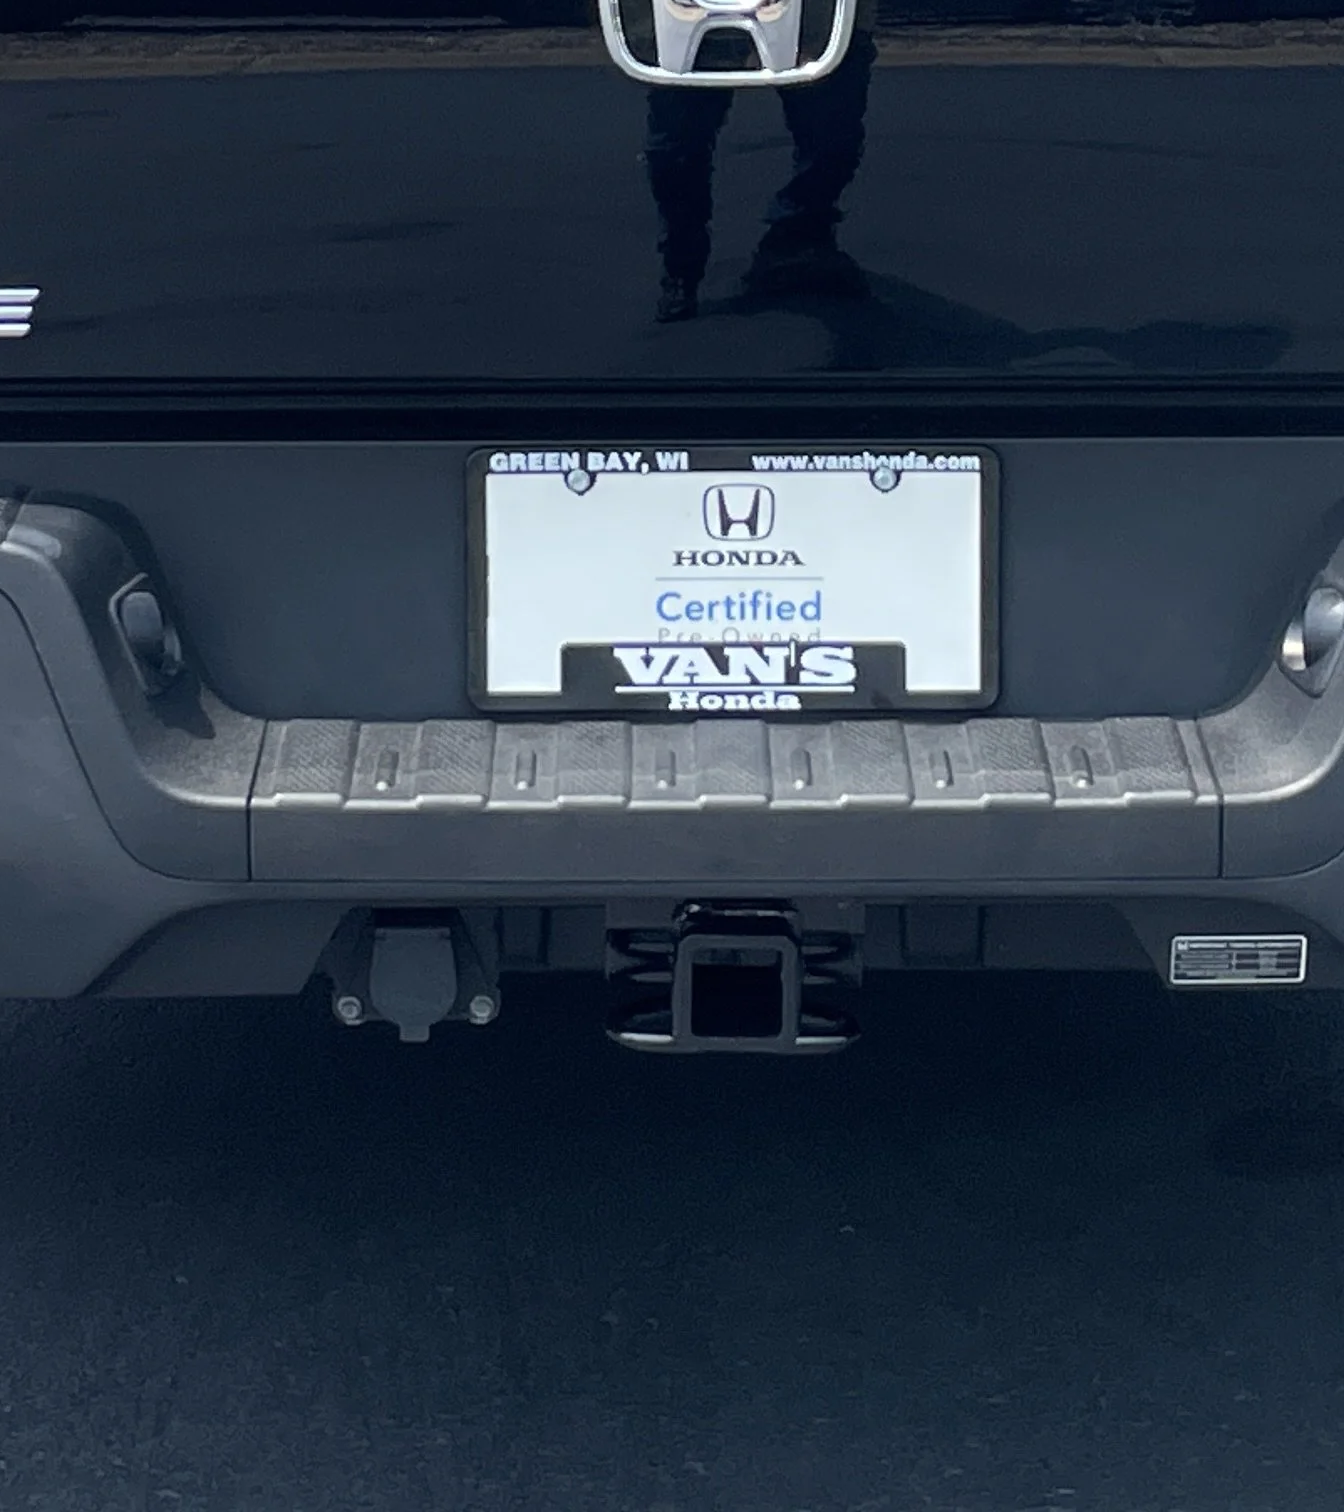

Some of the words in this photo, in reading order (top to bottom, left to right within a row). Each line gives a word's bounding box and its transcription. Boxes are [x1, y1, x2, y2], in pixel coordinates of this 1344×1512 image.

[489, 451, 581, 473] GREEN
[587, 451, 650, 475] BAY,
[655, 451, 689, 472] WI
[752, 450, 981, 471] www.vanshonda.com
[672, 549, 806, 567] HONDA
[656, 589, 823, 622] Certified
[657, 626, 822, 645] Pre-Owned
[613, 639, 857, 686] VAN'S
[668, 691, 803, 711] Honda
